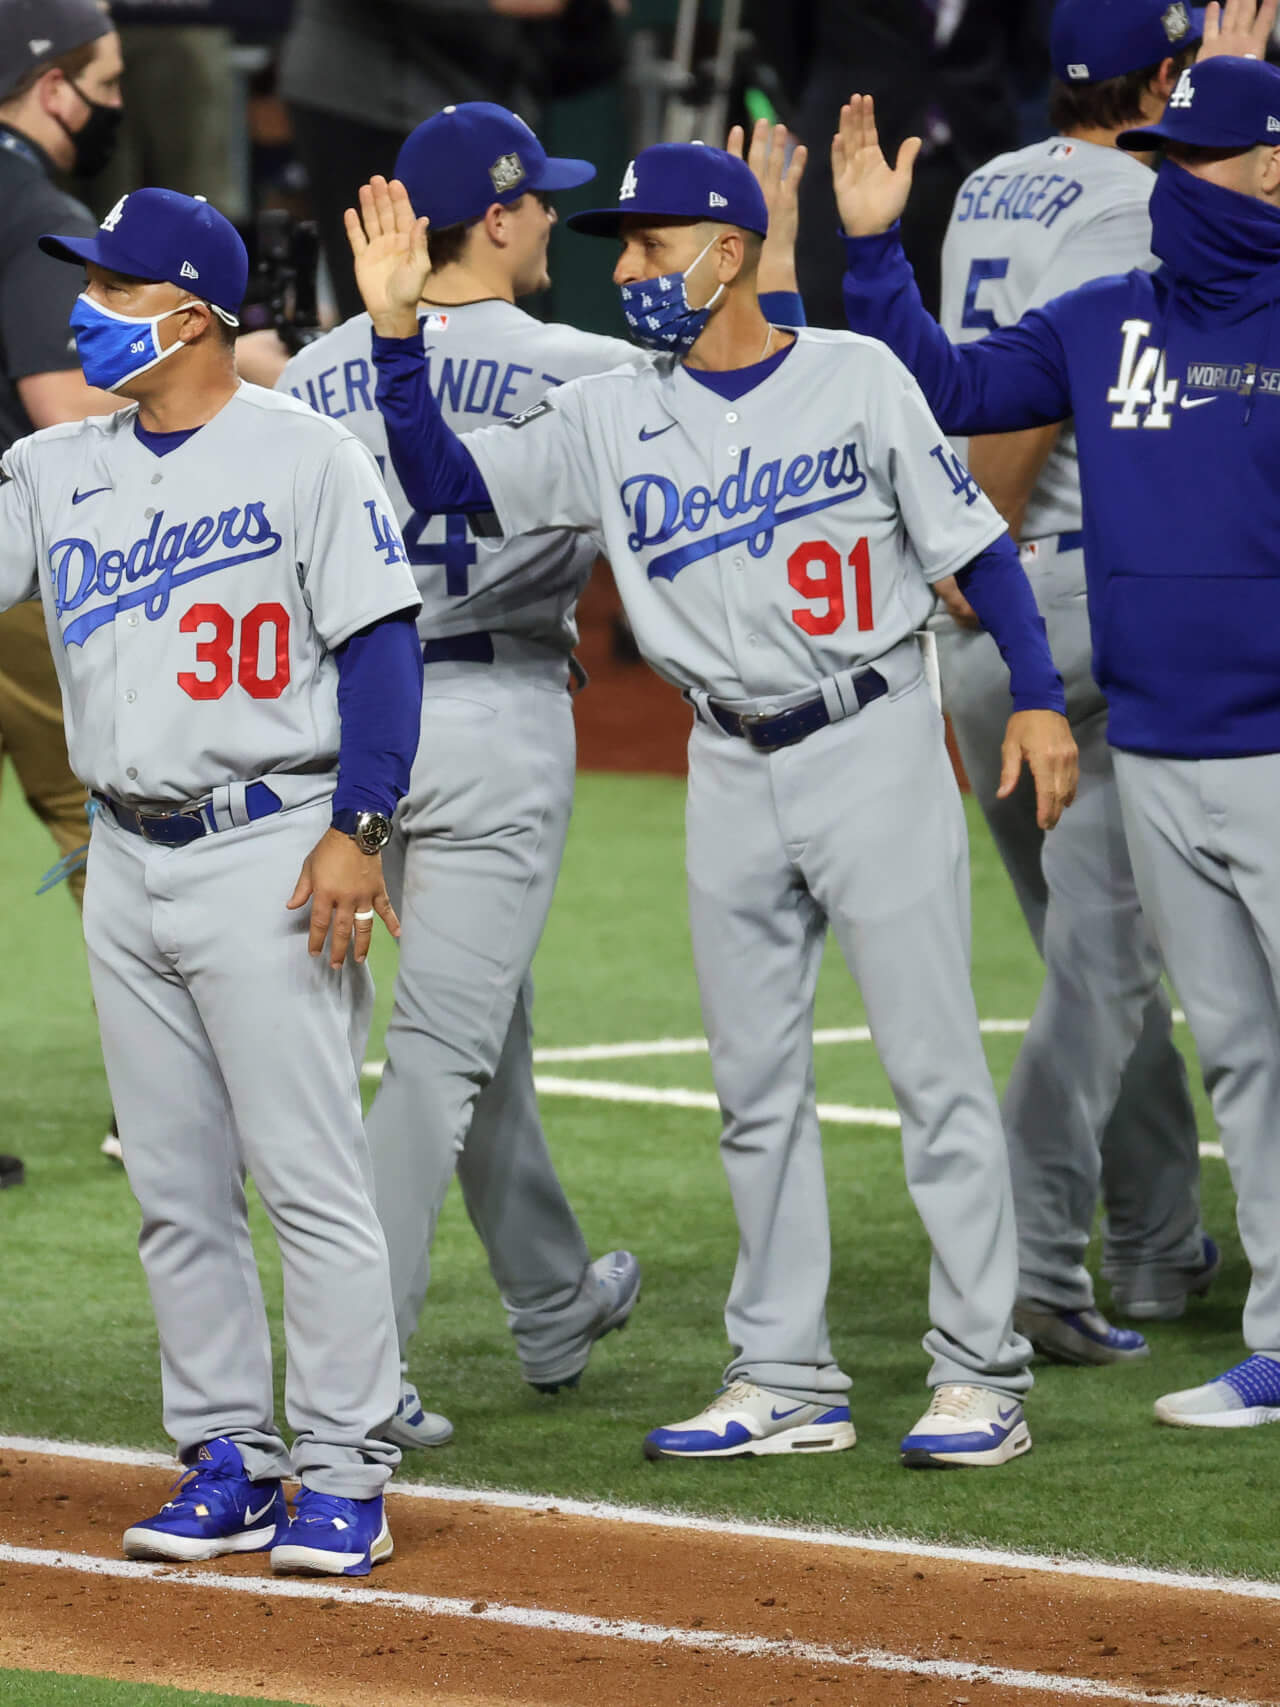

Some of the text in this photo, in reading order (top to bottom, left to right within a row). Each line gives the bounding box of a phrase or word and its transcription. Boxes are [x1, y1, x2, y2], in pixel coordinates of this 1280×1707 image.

[1169, 68, 1195, 108] LA
[619, 160, 638, 200] LA
[957, 173, 1084, 229] SEAGER
[961, 257, 1011, 333] 5
[130, 341, 145, 353] 30
[1106, 318, 1179, 430] LA
[1186, 364, 1241, 389] WORLD
[363, 499, 408, 566] LA
[620, 441, 867, 559] Dodgers
[48, 501, 281, 622] Dodgers
[786, 536, 874, 637] 91
[177, 602, 291, 701] 30
